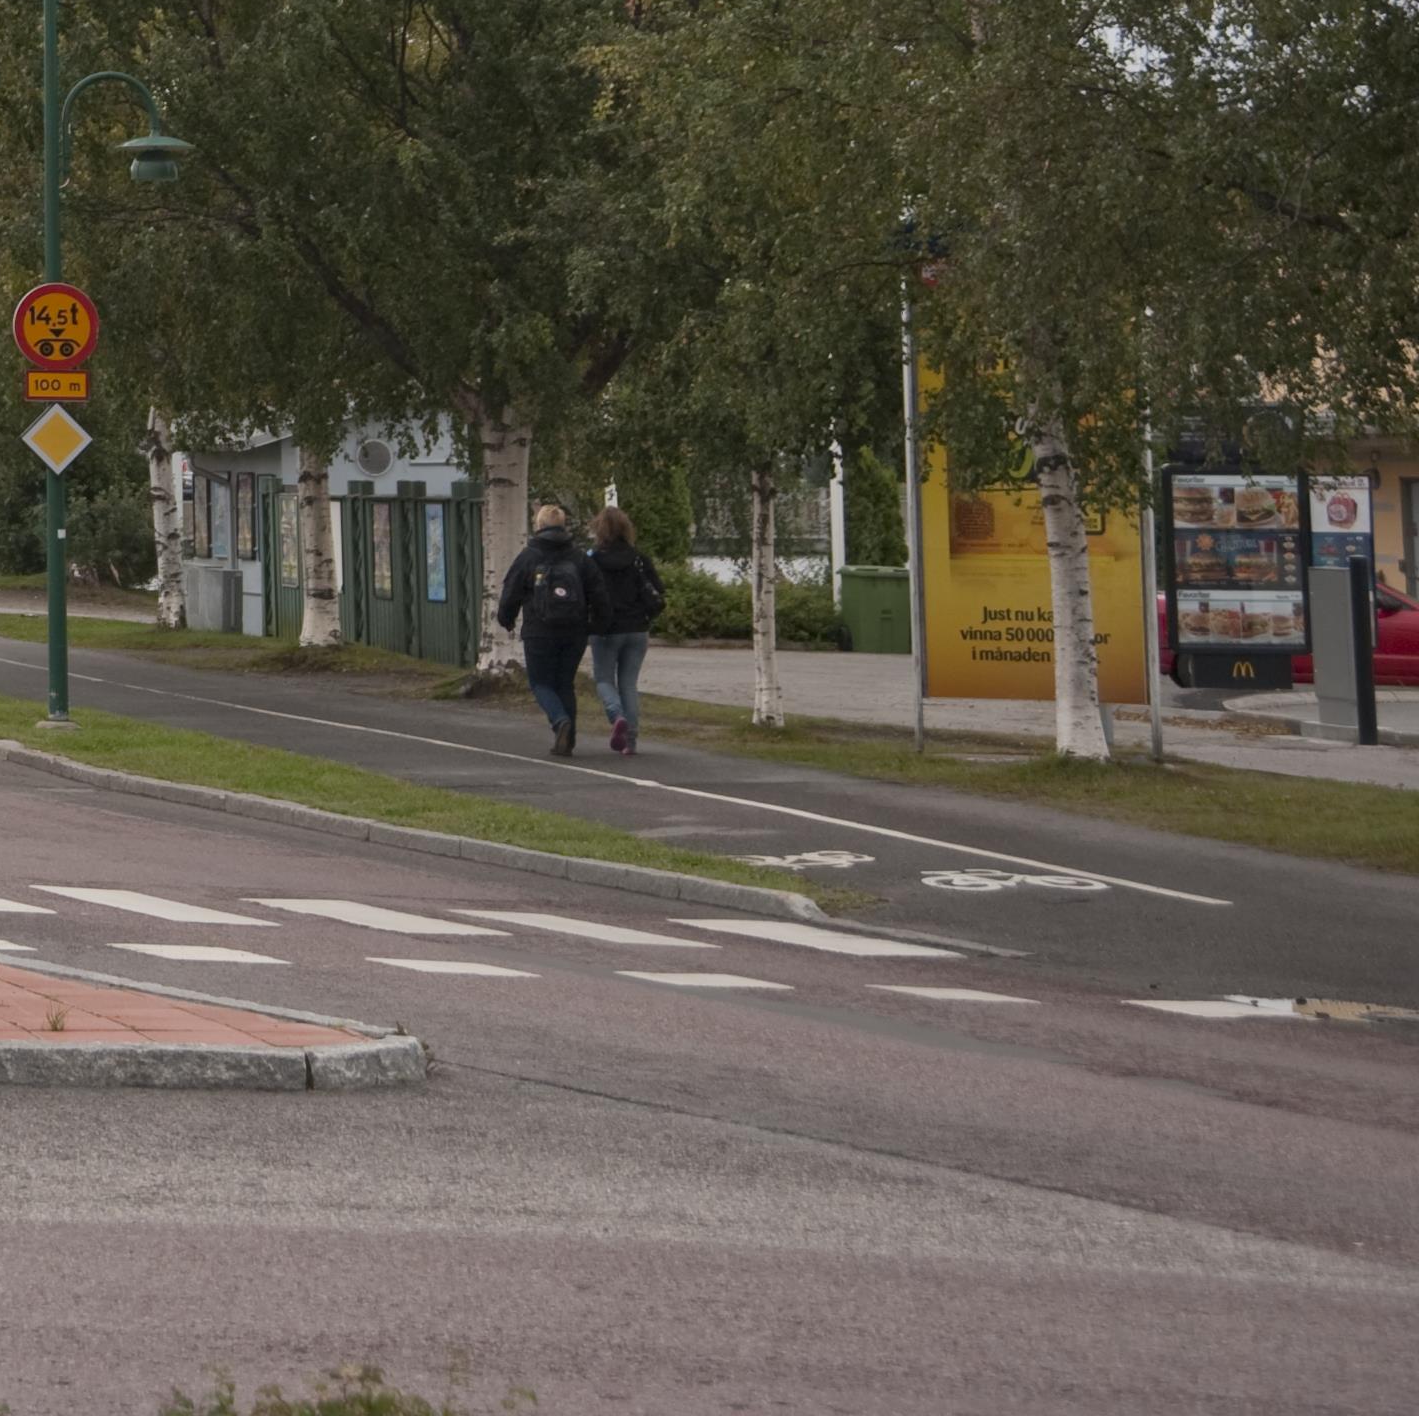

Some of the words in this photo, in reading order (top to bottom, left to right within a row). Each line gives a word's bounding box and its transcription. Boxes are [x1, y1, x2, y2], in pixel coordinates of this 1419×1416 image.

[35, 379, 61, 392] 100
[69, 382, 81, 392] m
[981, 606, 1011, 624] Just
[1015, 609, 1034, 622] nu
[1038, 606, 1055, 622] ka
[960, 626, 1002, 641] vinna
[971, 646, 977, 661] i
[979, 646, 1051, 663] månaden
